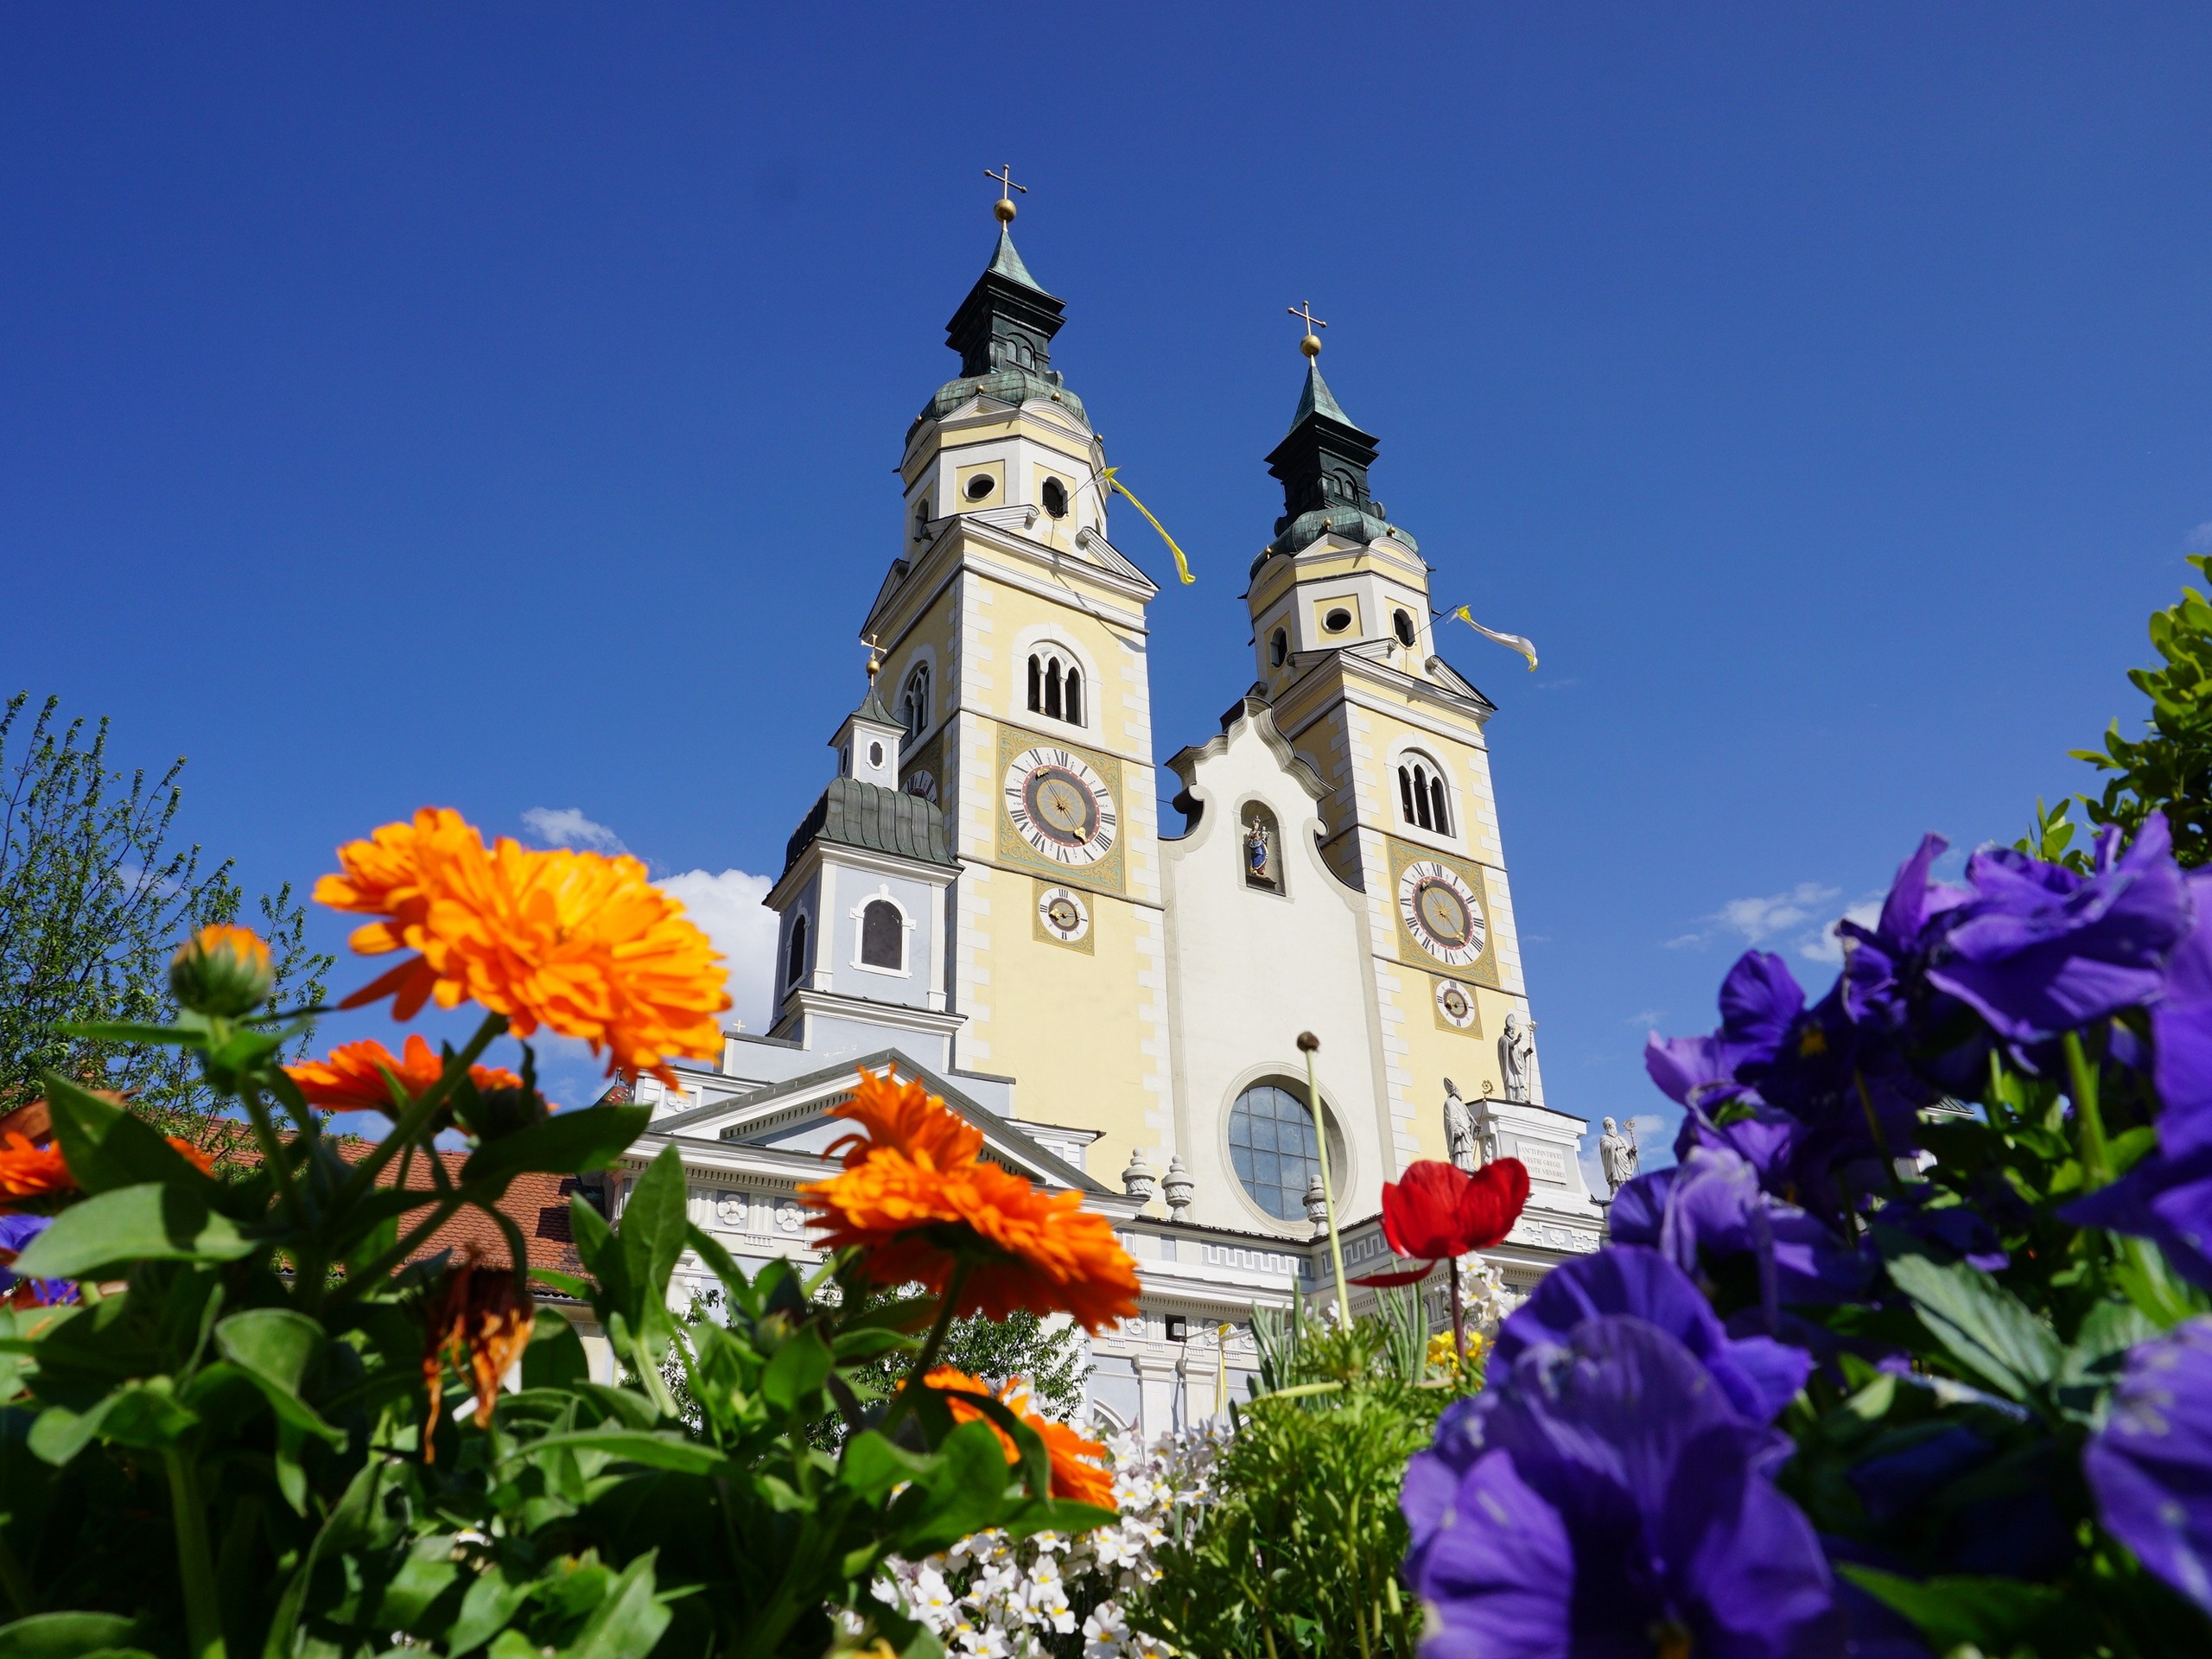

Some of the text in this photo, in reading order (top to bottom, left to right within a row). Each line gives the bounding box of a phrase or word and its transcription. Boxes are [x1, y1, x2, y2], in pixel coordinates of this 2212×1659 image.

[1079, 765, 1089, 778] I
[1094, 788, 1109, 798] II
[1100, 812, 1116, 826] III
